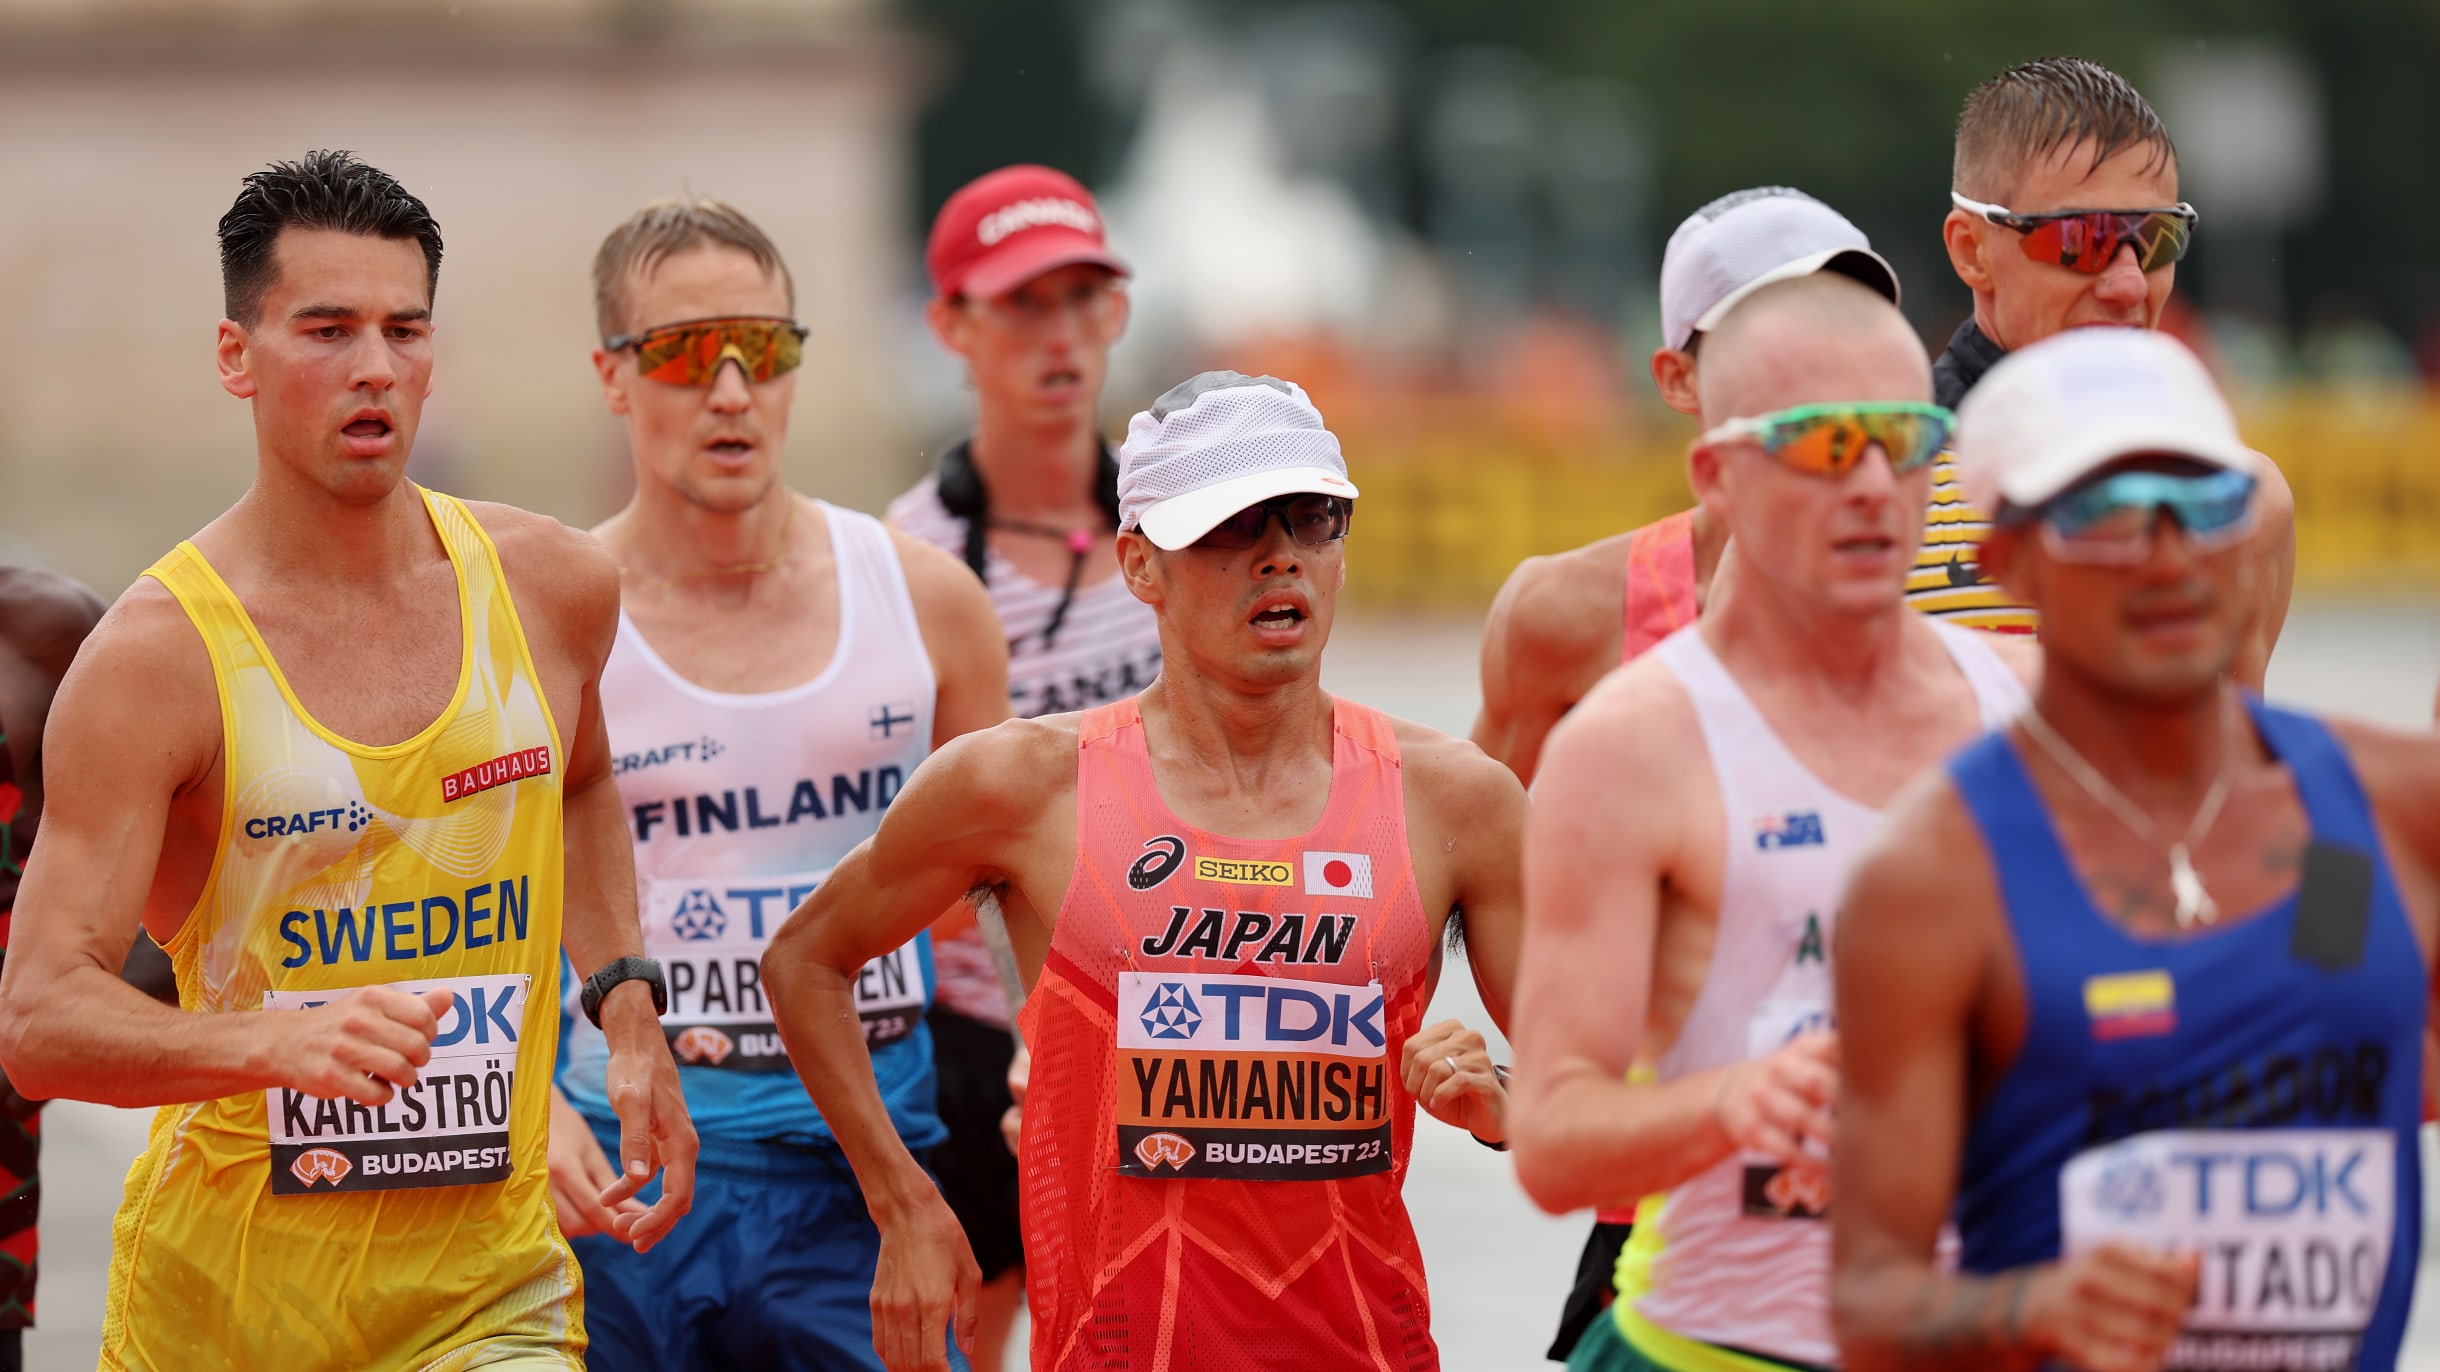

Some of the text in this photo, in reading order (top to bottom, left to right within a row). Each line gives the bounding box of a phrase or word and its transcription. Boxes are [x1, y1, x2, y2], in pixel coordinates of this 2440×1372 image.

[445, 748, 550, 798] BAUHAUS
[634, 766, 904, 842] FINLAND
[245, 807, 345, 840] CRAFT
[1199, 860, 1290, 884] SEIKO
[279, 874, 528, 969] SWEDEN
[1141, 905, 1358, 965] JAPAN
[670, 949, 908, 1014] PAREN
[1201, 983, 1387, 1048] TDK
[282, 1058, 515, 1138] KARLSTRÖ
[1131, 1057, 1388, 1122] YAMANISH
[362, 1147, 508, 1176] BUDAPEST
[1205, 1139, 1382, 1165] BUDAPEST 23
[2168, 1148, 2368, 1220] TDK
